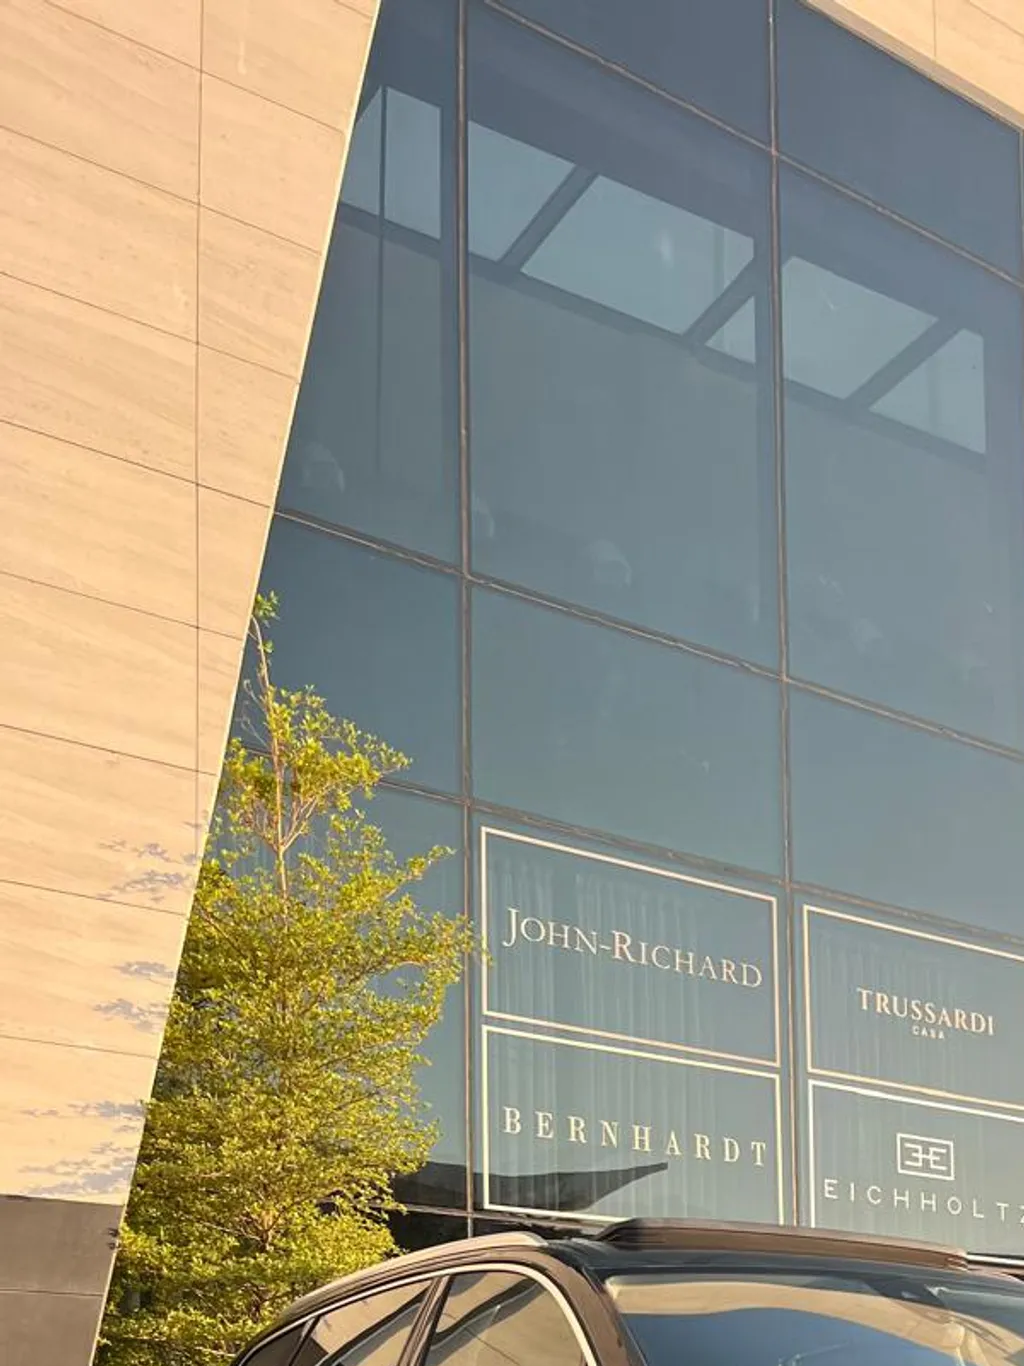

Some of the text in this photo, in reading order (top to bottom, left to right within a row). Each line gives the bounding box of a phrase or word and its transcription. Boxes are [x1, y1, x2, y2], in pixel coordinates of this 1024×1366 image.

[502, 907, 763, 988] JOHN-RICHARD
[856, 987, 995, 1036] TRUSSARDI
[912, 1026, 945, 1039] CASA
[503, 1107, 766, 1166] BERNHARDT
